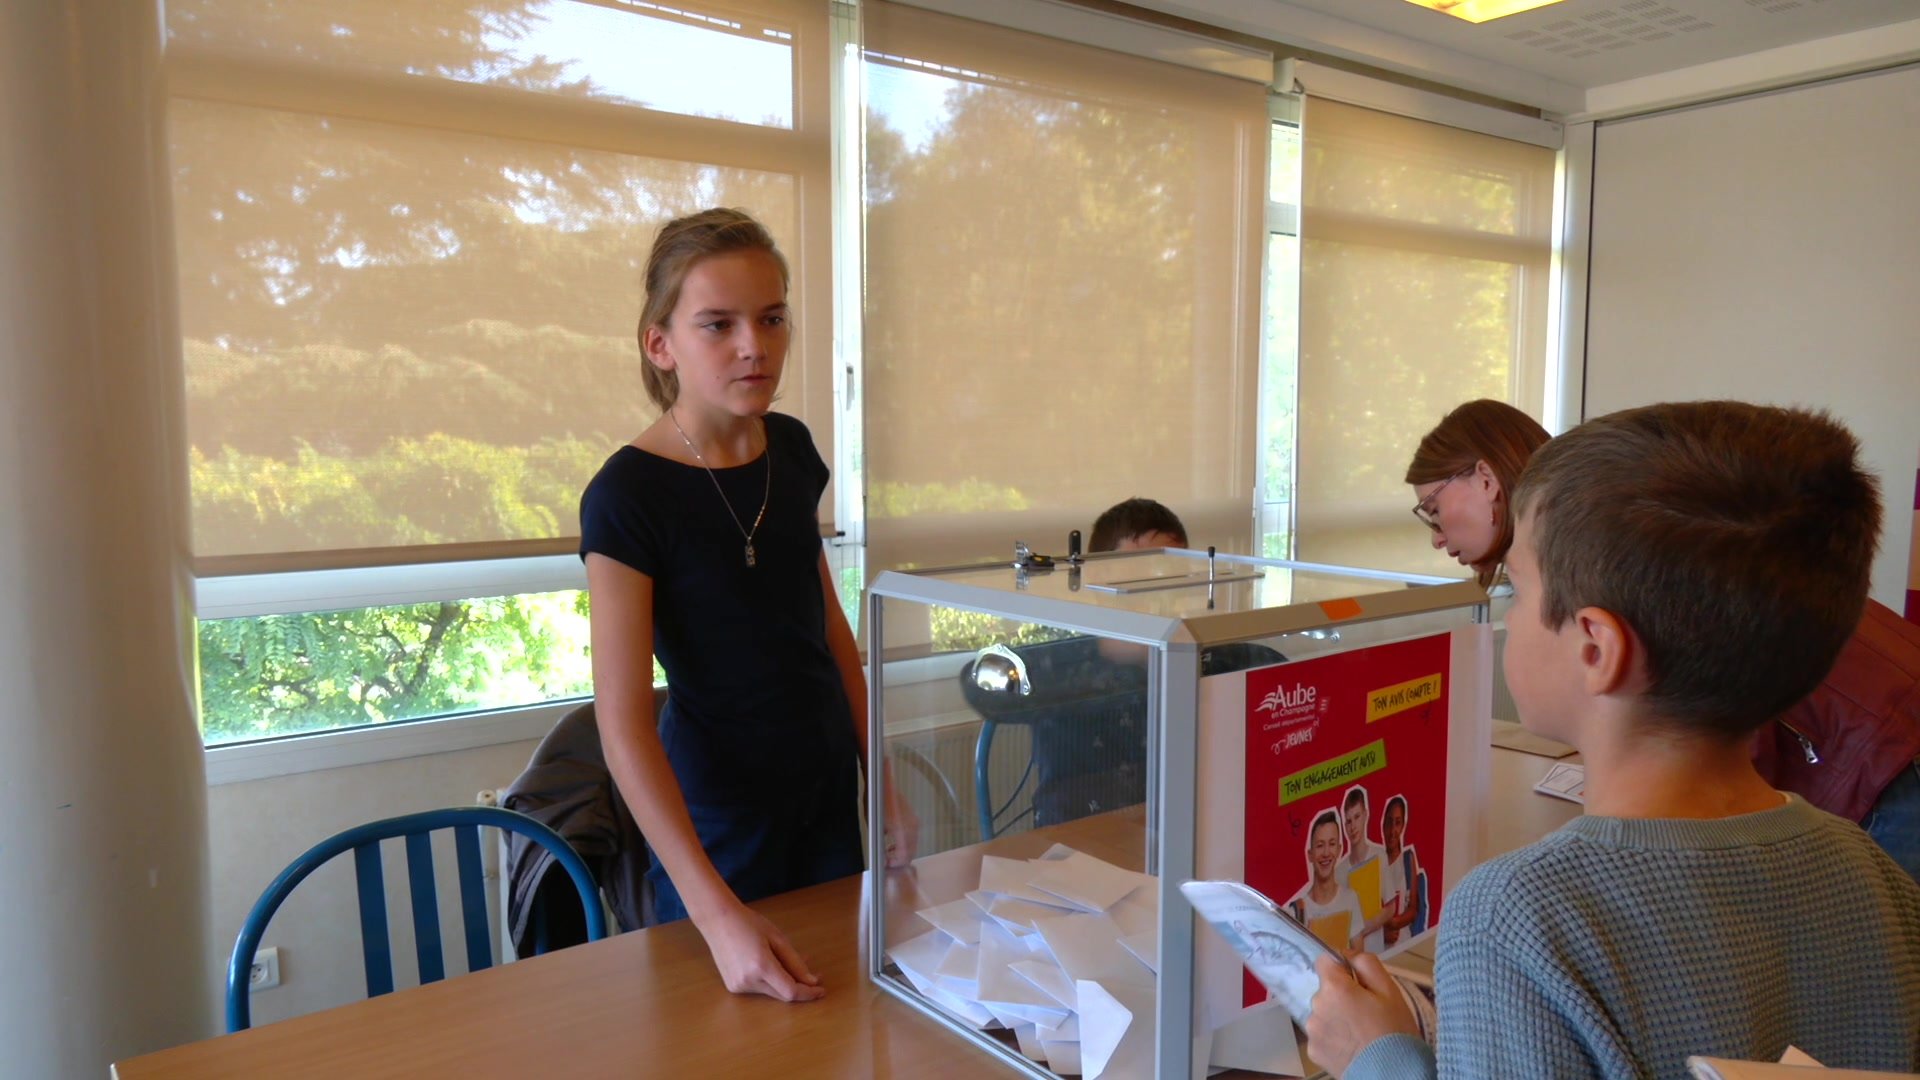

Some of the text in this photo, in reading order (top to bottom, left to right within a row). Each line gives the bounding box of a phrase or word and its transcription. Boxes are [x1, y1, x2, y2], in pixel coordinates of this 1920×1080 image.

[1273, 682, 1317, 711] Aube
[1280, 703, 1316, 717] Champagne
[1373, 695, 1388, 712] TON
[1389, 689, 1405, 709] AVIS
[1406, 682, 1432, 703] COMPTE
[1285, 727, 1313, 750] JEUNES
[1284, 779, 1301, 796] TON
[1303, 757, 1359, 790] ENGAGEMENT
